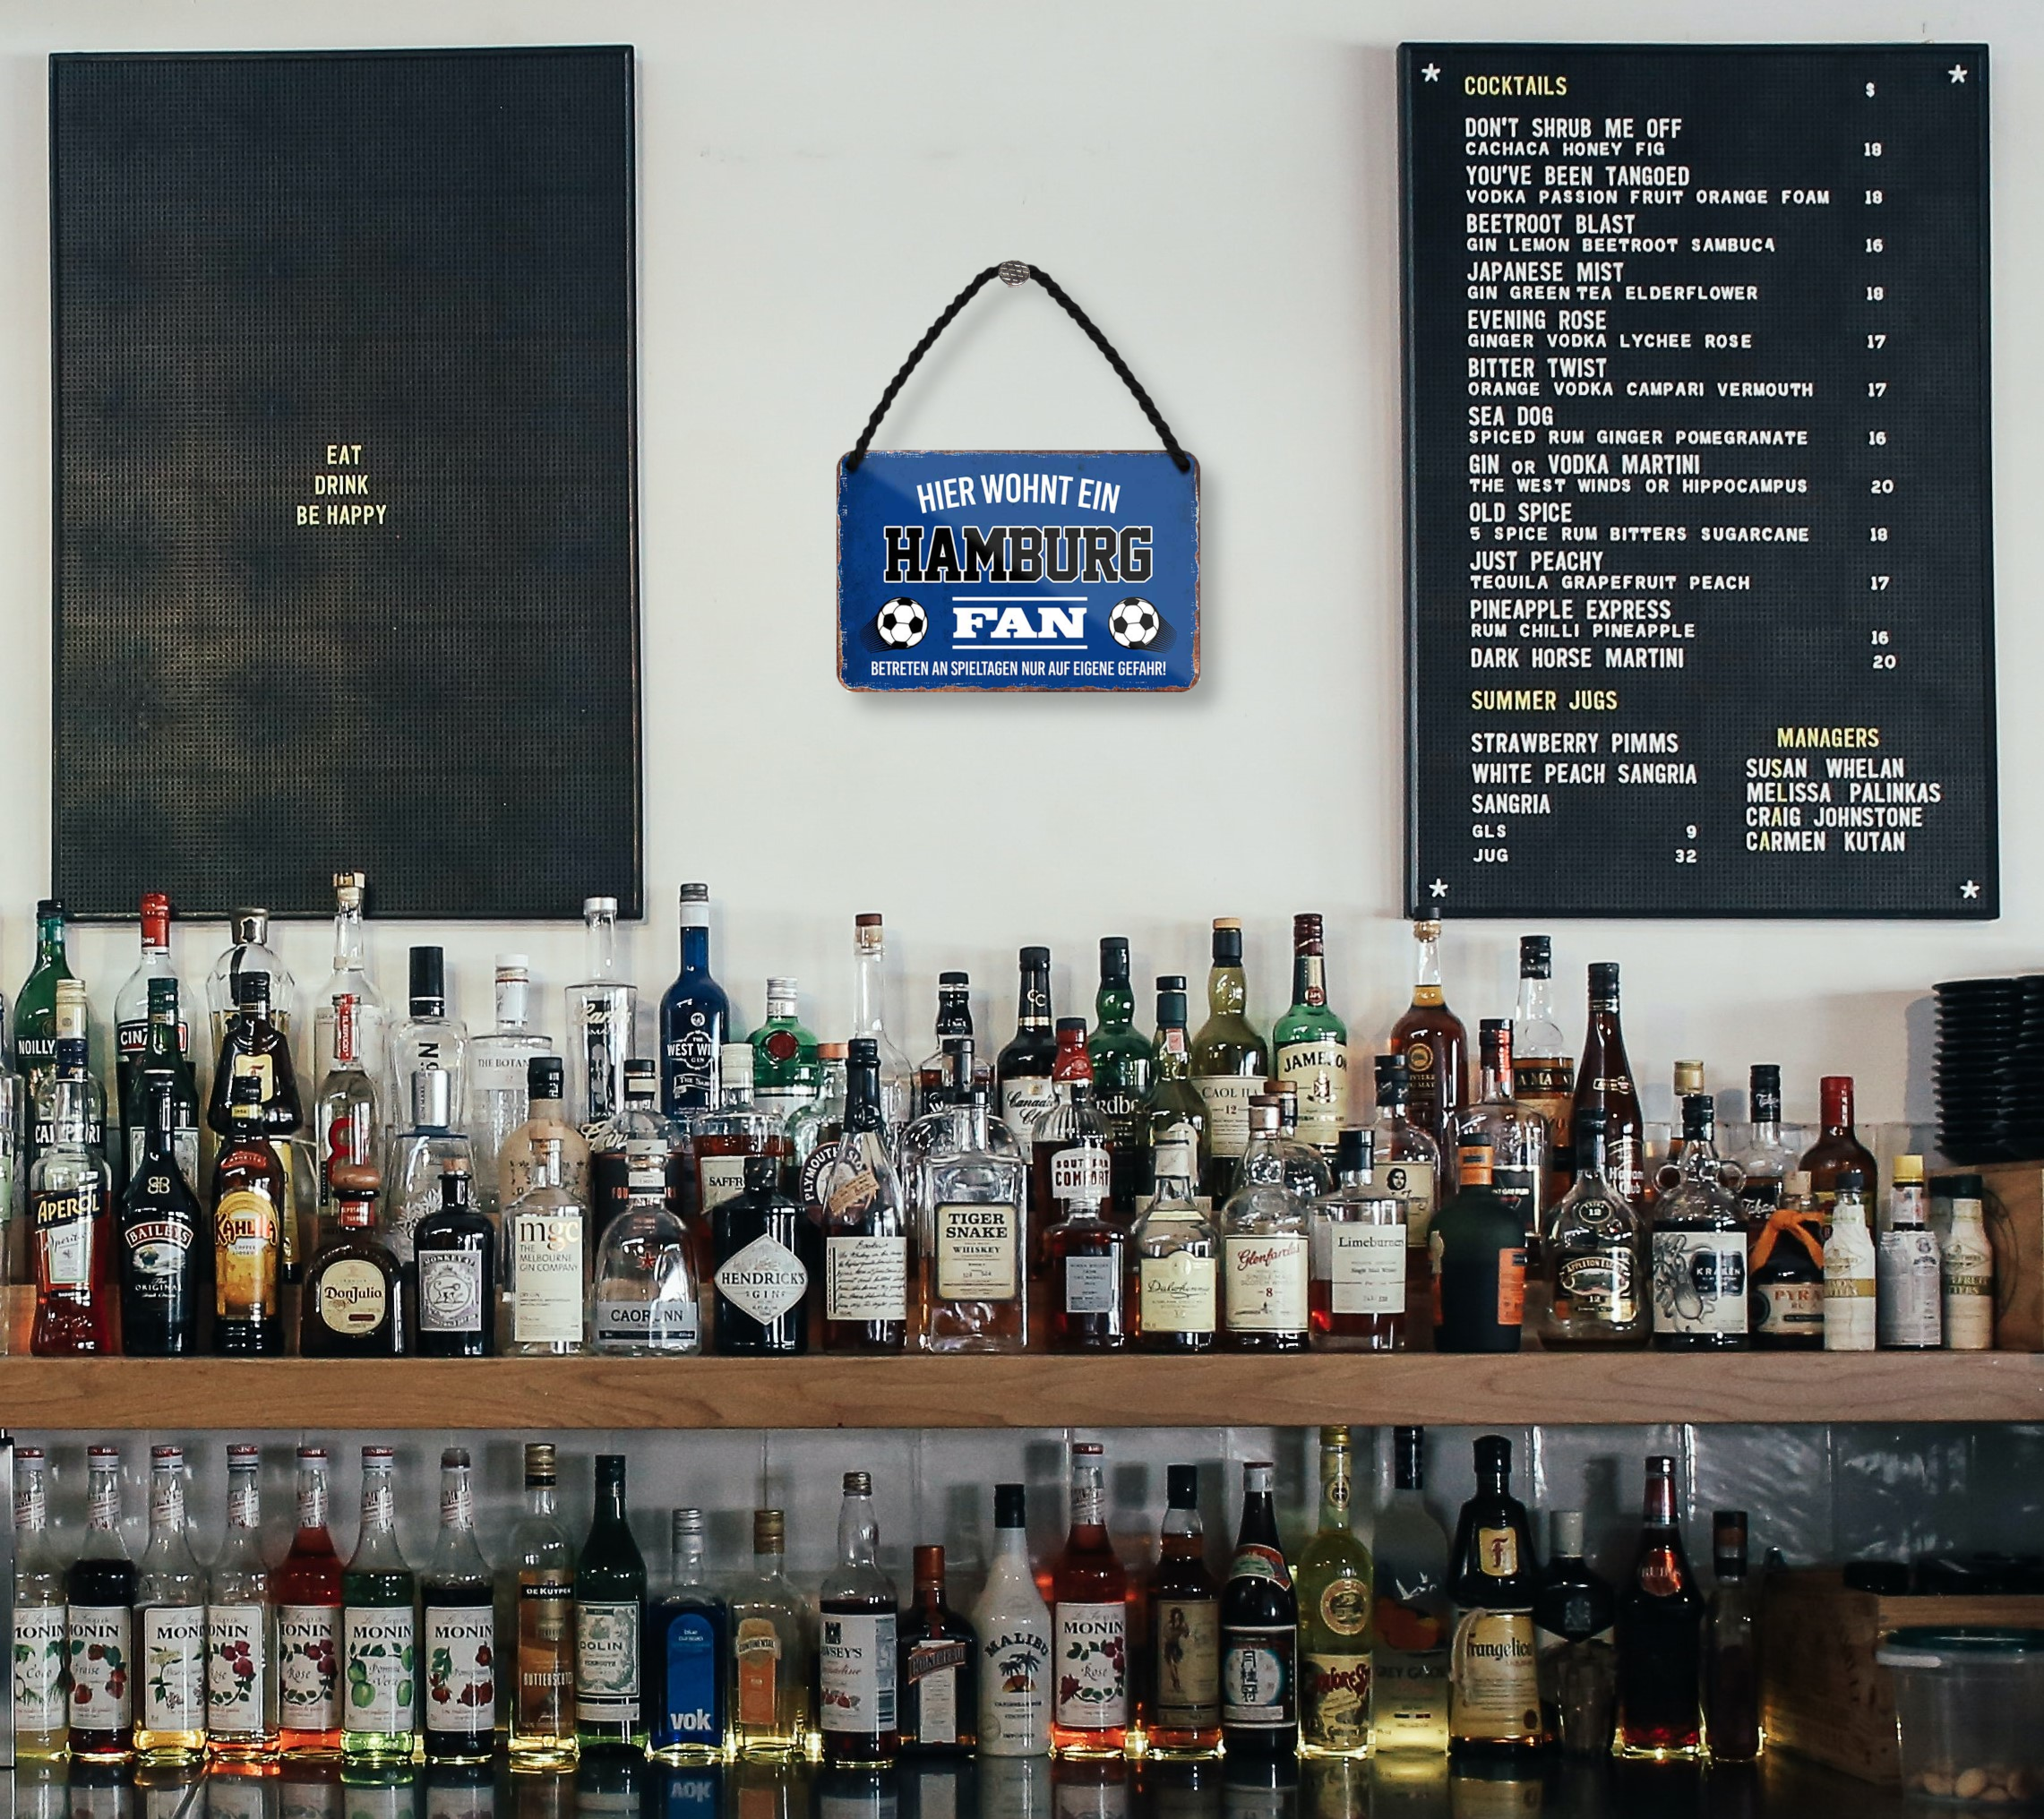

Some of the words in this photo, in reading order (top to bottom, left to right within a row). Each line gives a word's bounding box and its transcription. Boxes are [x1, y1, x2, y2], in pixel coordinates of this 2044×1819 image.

[1464, 75, 1567, 96] COCKTAILS
[1464, 116, 1519, 138] DON'T
[1532, 117, 1592, 139] SHRUB
[1604, 117, 1635, 139] ME
[1646, 117, 1682, 139] OFF
[1465, 141, 1550, 157] CACHACA
[1562, 142, 1623, 157] HONEY
[1636, 142, 1665, 157] FIG
[1864, 142, 1882, 158] 18
[1465, 164, 1532, 186] YOU'VE
[1544, 165, 1593, 186] BEEN
[1604, 165, 1690, 187] TANGOED
[1465, 189, 1526, 204] VODKA
[1539, 189, 1618, 205] PASSION
[1630, 189, 1684, 205] FRUIT
[1696, 189, 1768, 205] ORANGE
[1781, 189, 1830, 205] FOAM
[1865, 190, 1883, 205] 18
[1466, 213, 1563, 235] BEETROOT
[1576, 213, 1636, 235] BLAST
[1466, 237, 1497, 253] GIN
[1509, 237, 1570, 253] LEMON
[1582, 237, 1679, 253] BEETROOT
[1691, 237, 1775, 253] SAMBUCA
[1865, 237, 1884, 253] 16
[1466, 261, 1564, 282] JAPANESE
[1576, 262, 1624, 283] MIST
[1467, 285, 1498, 300] GIN
[1509, 285, 1571, 301] GREEN
[1576, 285, 1612, 301] TEA
[1625, 285, 1758, 301] ELDERFLOWER
[1866, 286, 1884, 301] 18
[1467, 309, 1546, 330] EVENING
[1559, 309, 1607, 331] ROSE
[1467, 333, 1534, 348] GINGER
[1546, 333, 1607, 348] VODKA
[1619, 333, 1692, 348] LYCHEE
[1705, 333, 1752, 349] ROSE
[1867, 334, 1886, 349] 17
[1468, 357, 1535, 379] BITTER
[1546, 357, 1608, 379] TWIST
[1467, 381, 1541, 397] ORANGE
[1553, 381, 1614, 397] VODKA
[1626, 382, 1705, 397] CAMPARI
[1717, 382, 1814, 398] VERMOUTH
[1868, 382, 1887, 398] 17
[1468, 405, 1505, 427] SEA
[1516, 406, 1554, 426] DOG
[1469, 429, 1536, 445] SPICED
[1548, 429, 1585, 445] RUM
[1596, 429, 1663, 445] GINGER
[1675, 430, 1808, 446] POMEGRANATE
[1868, 430, 1887, 446] 16
[327, 444, 362, 466] EAT
[1469, 453, 1499, 475] GIN
[1547, 453, 1610, 476] VODKA
[1621, 453, 1700, 476] MARTINI
[314, 474, 369, 495] DRINK
[916, 476, 976, 513] HIER
[980, 473, 1073, 505] WOHNT
[1078, 477, 1121, 514] EIN
[1469, 477, 1505, 493] THE
[1516, 477, 1567, 493] WEST
[1576, 477, 1631, 493] WINDS
[1682, 478, 1808, 494] HIPPOCAMPUS
[1870, 479, 1894, 494] 20
[296, 504, 320, 527] BE
[327, 504, 387, 526] HAPPY
[1469, 502, 1506, 523] OLD
[1517, 502, 1573, 523] SPICE
[1469, 526, 1481, 541] 5
[1494, 526, 1548, 542] SPICE
[1561, 526, 1598, 542] RUM
[1610, 526, 1688, 542] BITTERS
[1701, 527, 1809, 543] SUGARCANE
[1869, 527, 1888, 543] 18
[883, 526, 1153, 584] HAMBURG
[1469, 550, 1518, 571] JUST
[1530, 550, 1603, 572] PEACHY
[1470, 574, 1549, 590] TEQUILA
[1561, 574, 1677, 590] GRAPEFRUIT
[1689, 575, 1750, 590] PEACH
[1870, 575, 1890, 591] 17
[1470, 598, 1574, 621] PINEAPPLE
[1586, 599, 1671, 621] EXPRESS
[952, 607, 1087, 639] FAN
[1471, 622, 1507, 638] RUM
[1519, 622, 1580, 639] CHILLI
[1593, 622, 1696, 639] PINEAPPLE
[1870, 630, 1889, 646] 16
[871, 661, 928, 676] BETRETEN
[932, 661, 948, 676] AN
[950, 661, 1018, 676] SPIELTAGEN
[1021, 661, 1044, 676] NUR
[1048, 661, 1070, 676] AUF
[1073, 661, 1114, 676] EIGENE
[1118, 661, 1166, 676] GEFAHR!
[1471, 647, 1520, 669] DARK
[1532, 647, 1593, 669] HORSE
[1605, 647, 1684, 669] MARTINI
[1872, 654, 1897, 670] 20
[1471, 690, 1557, 711] SUMMER
[1568, 690, 1618, 710] JUGS
[1471, 732, 1599, 754] STRAWBERRY
[1611, 732, 1679, 754] PIMMS
[1777, 727, 1880, 749] MANAGERS
[1472, 762, 1533, 785] WHITE
[1544, 762, 1606, 785] PEACH
[1617, 763, 1697, 785] SANGRIA
[1746, 757, 1808, 779] SUSAN
[1825, 757, 1904, 779] WHELAN
[1747, 782, 1832, 803] MELISSA
[1850, 782, 1942, 804] PALINKAS
[1472, 793, 1551, 815] SANGRIA
[1746, 806, 1801, 828] CRAIG
[1813, 806, 1923, 828] JOHNSTONE
[1472, 824, 1507, 838] GLS
[1686, 824, 1697, 839] 9
[1746, 830, 1826, 852] CARMEN
[1843, 830, 1906, 853] KUTAN
[1473, 847, 1508, 863] JUG
[1675, 848, 1697, 863] 32
[18, 1039, 56, 1055] NOILLY
[667, 1042, 693, 1057] WEST
[1201, 1086, 1238, 1098] CAOL
[1224, 1105, 1238, 1115] 12
[803, 1146, 841, 1202] PLYMOUTH
[37, 1195, 100, 1224] APEROL
[948, 1213, 1005, 1225] TIGER
[520, 1222, 580, 1252] mgc
[946, 1227, 1008, 1239] SNAKE
[520, 1244, 537, 1253] THE
[520, 1254, 572, 1263] MELBOURNE
[952, 1245, 1001, 1254] WHISKEY
[520, 1263, 536, 1272] GIN
[537, 1263, 579, 1272] COMPANY
[721, 1272, 806, 1286] HENDRICK'S
[751, 1289, 781, 1299] GIN
[610, 1308, 684, 1324] CAORNN
[353, 1624, 413, 1638] MONIN
[434, 1624, 494, 1638] MONIN
[1063, 1621, 1124, 1635] MONIN
[580, 1641, 623, 1652] DOLIN
[984, 1632, 1050, 1658] MALIBU
[669, 1708, 713, 1731] vok
